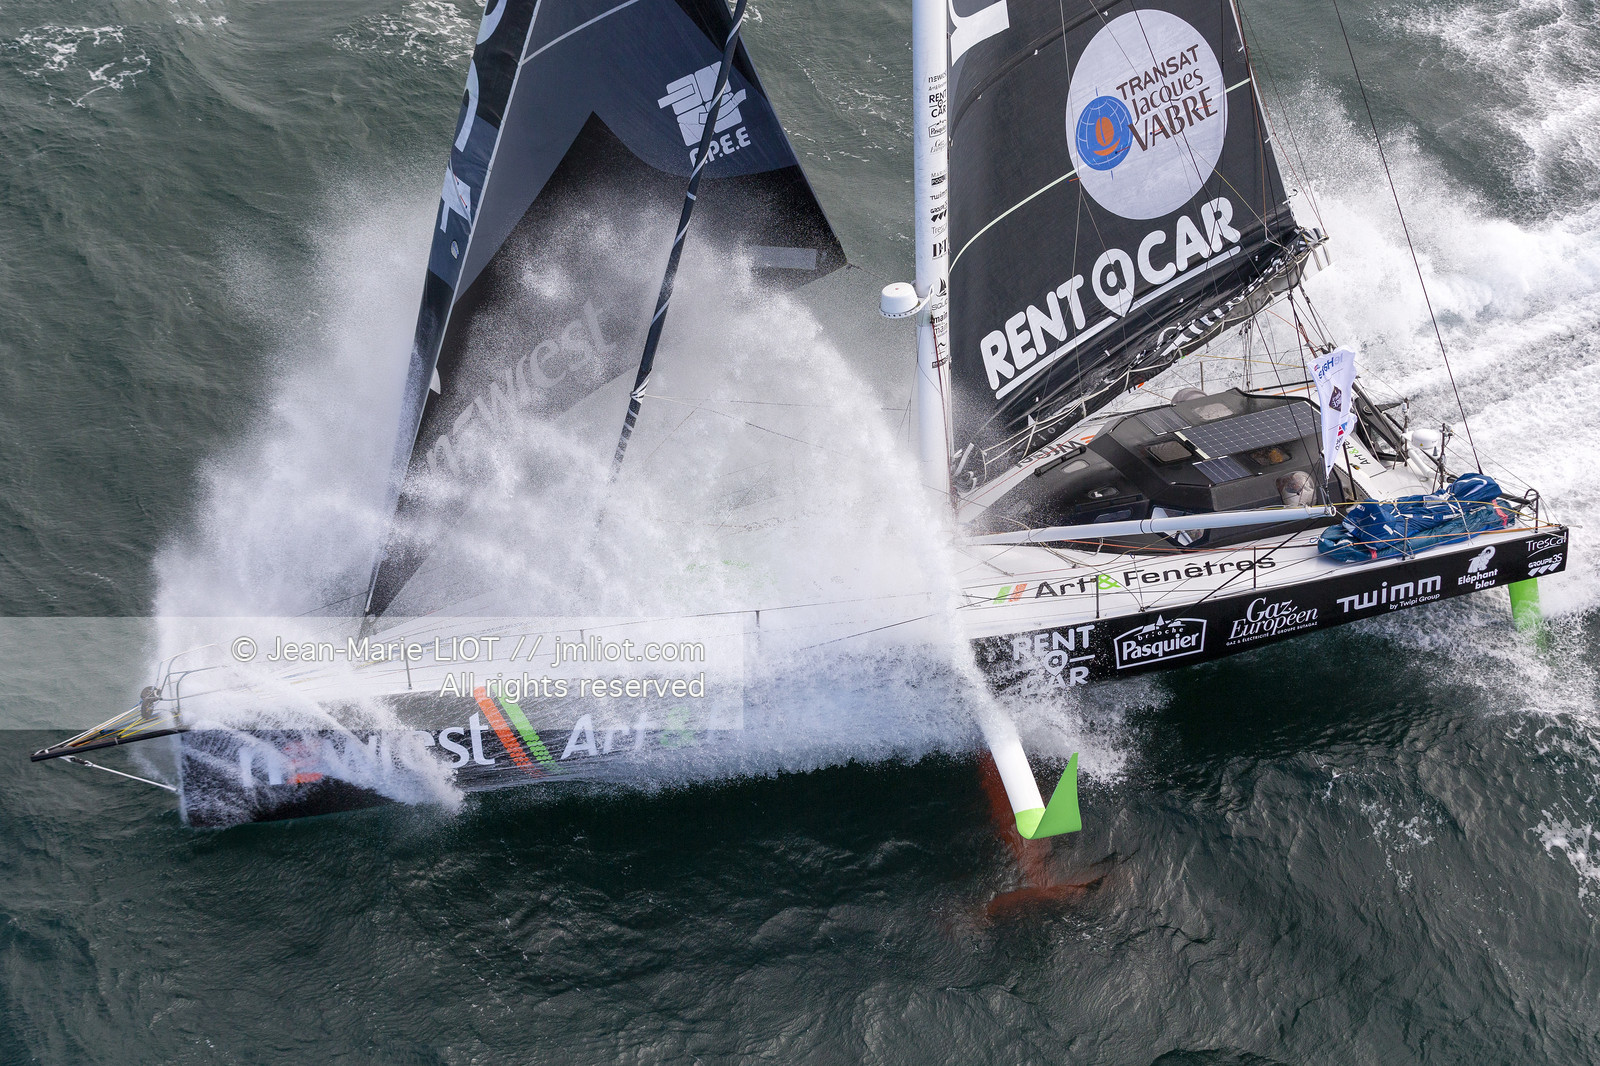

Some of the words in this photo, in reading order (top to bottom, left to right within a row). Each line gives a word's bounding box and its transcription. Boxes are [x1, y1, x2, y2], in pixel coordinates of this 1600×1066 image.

[1116, 44, 1199, 100] TRANSAT
[1128, 86, 1218, 152] VABRE
[980, 275, 1085, 391] RENT
[1137, 197, 1241, 285] CAR
[1525, 531, 1567, 552] Trescal
[1457, 569, 1499, 586] Eléphant
[1474, 579, 1496, 590] bleu
[1246, 597, 1293, 623] Gaz
[1400, 598, 1418, 608] Twipi
[1419, 593, 1441, 604] Group
[1228, 606, 1319, 640] Européen
[1012, 624, 1096, 661] RENT
[1122, 632, 1200, 661] Pasquier
